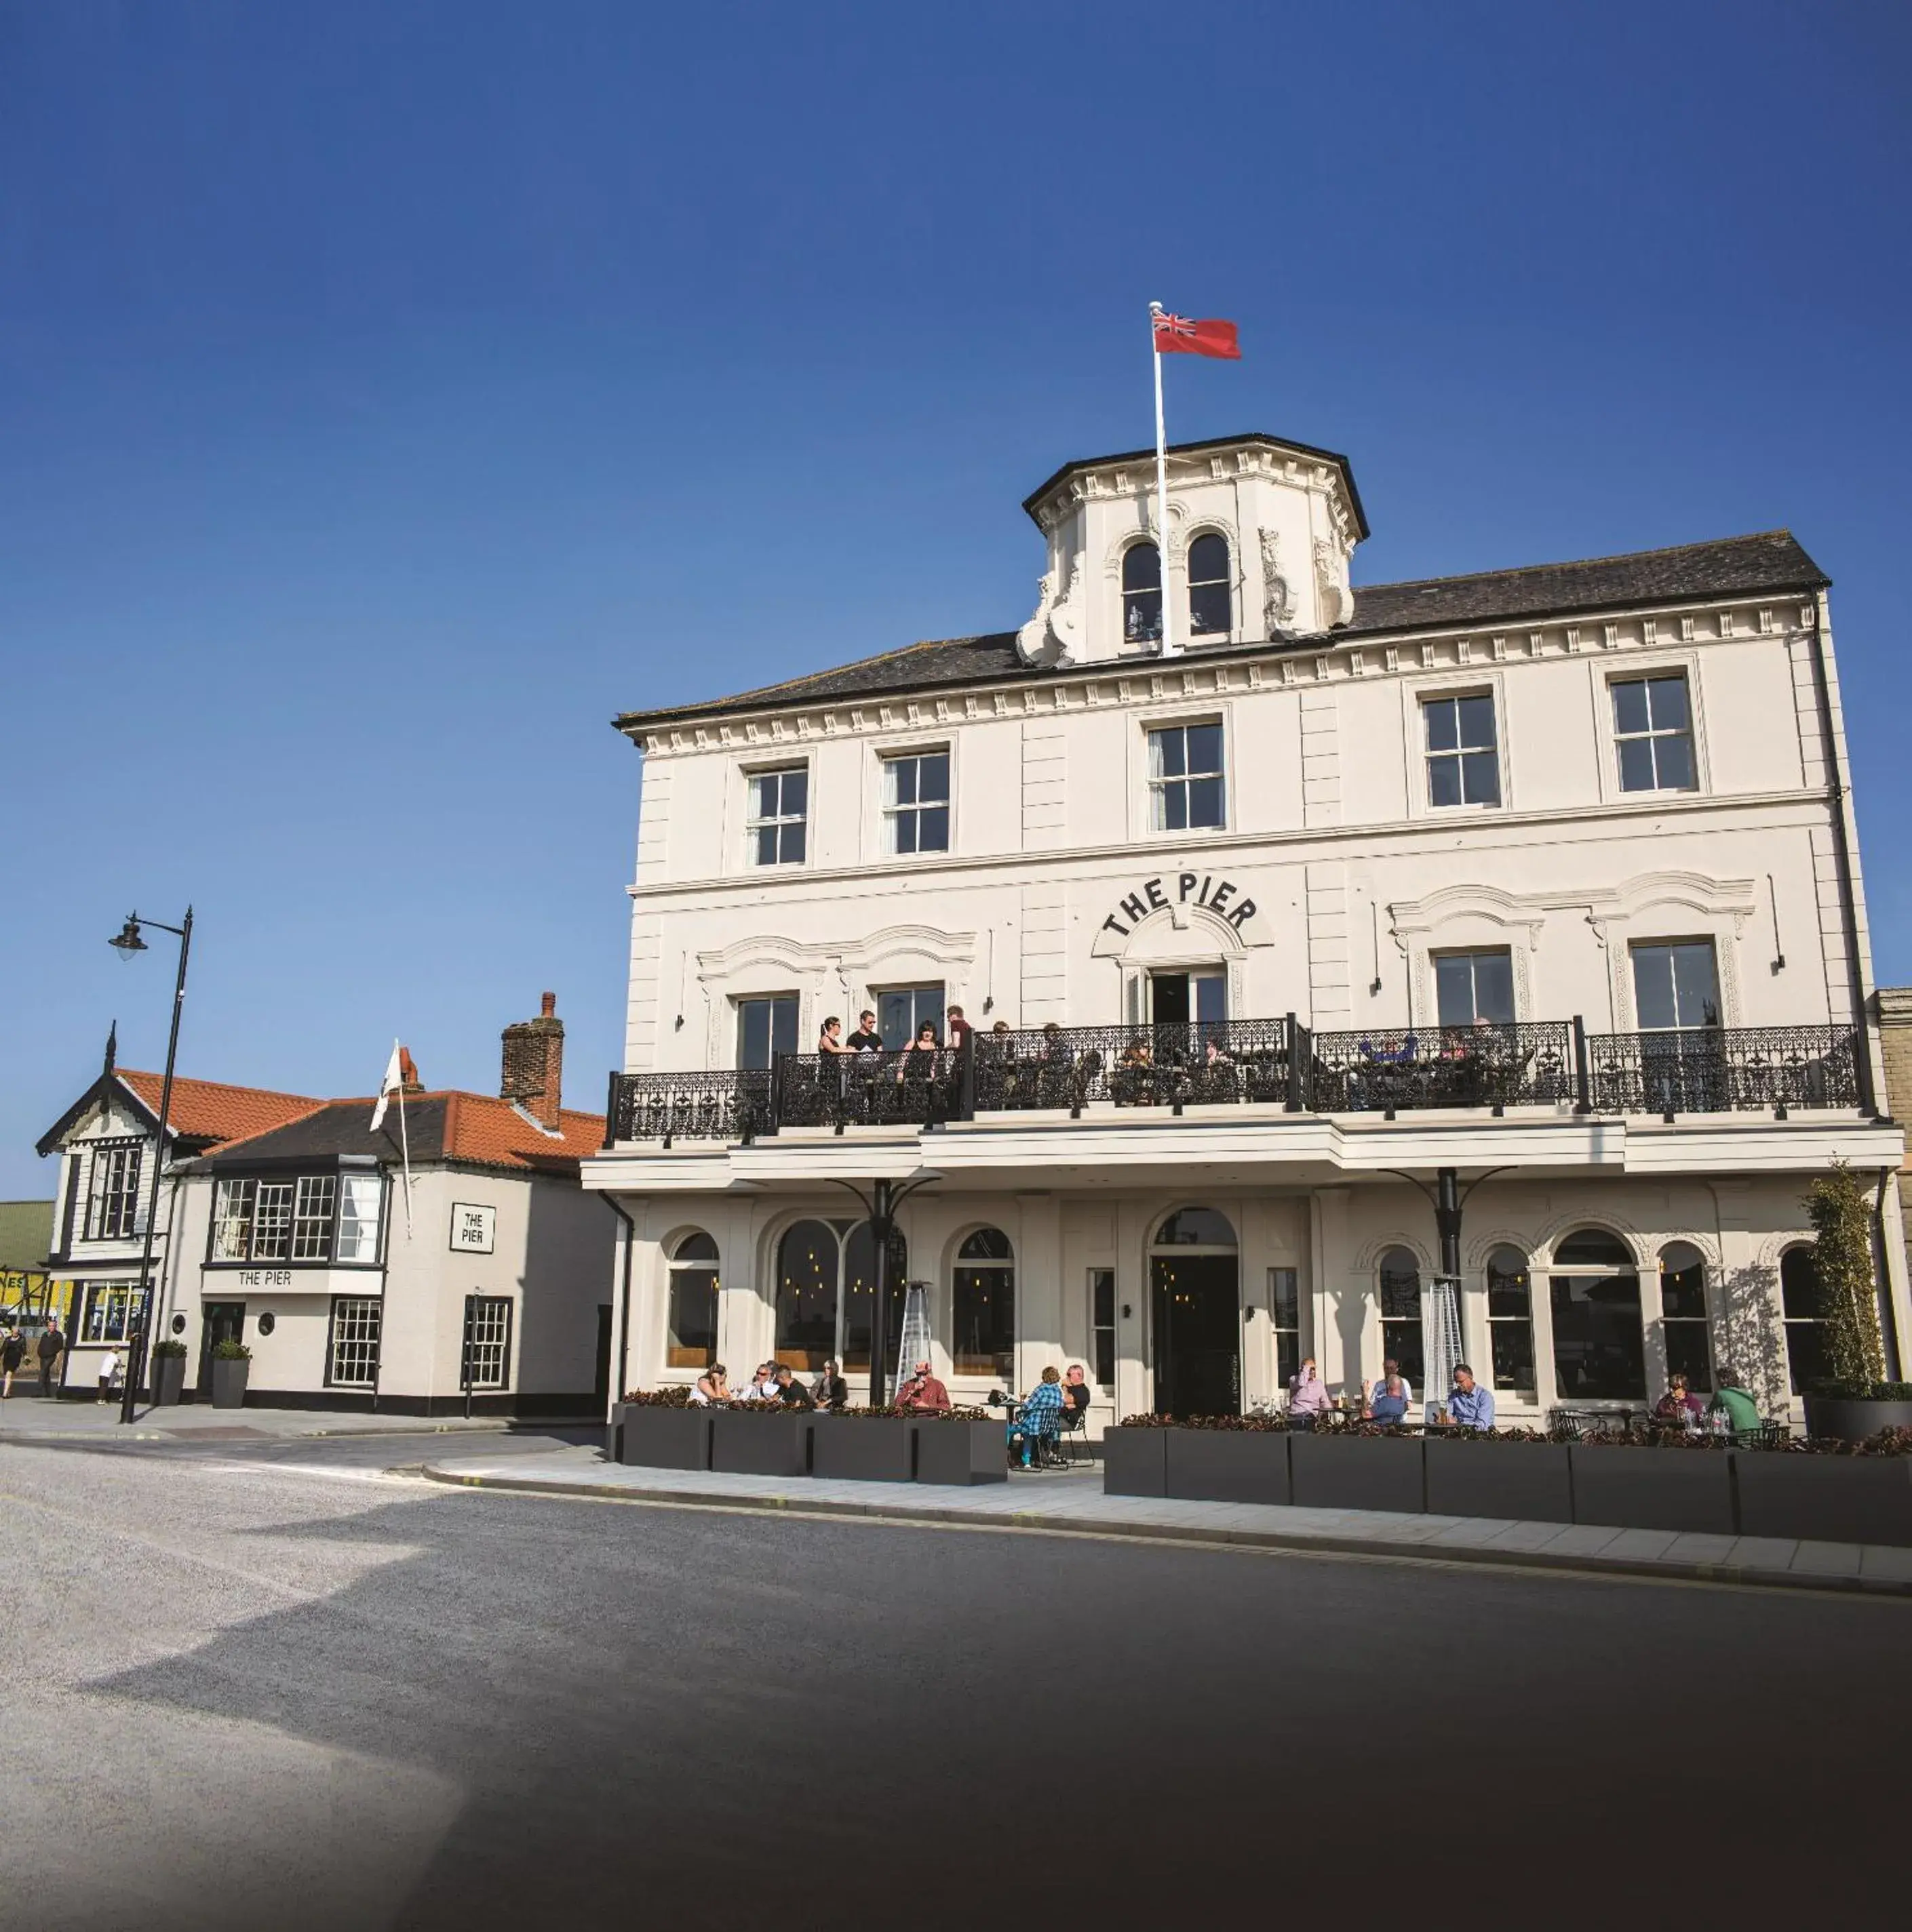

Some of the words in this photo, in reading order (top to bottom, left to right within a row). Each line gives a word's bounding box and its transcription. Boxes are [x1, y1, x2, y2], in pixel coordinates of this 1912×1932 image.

[1102, 878, 1169, 936] THE
[1179, 873, 1257, 928] PIER
[465, 1213, 483, 1227] THE
[462, 1228, 483, 1244] PIER
[239, 1271, 260, 1285] THE
[265, 1271, 291, 1285] PIER
